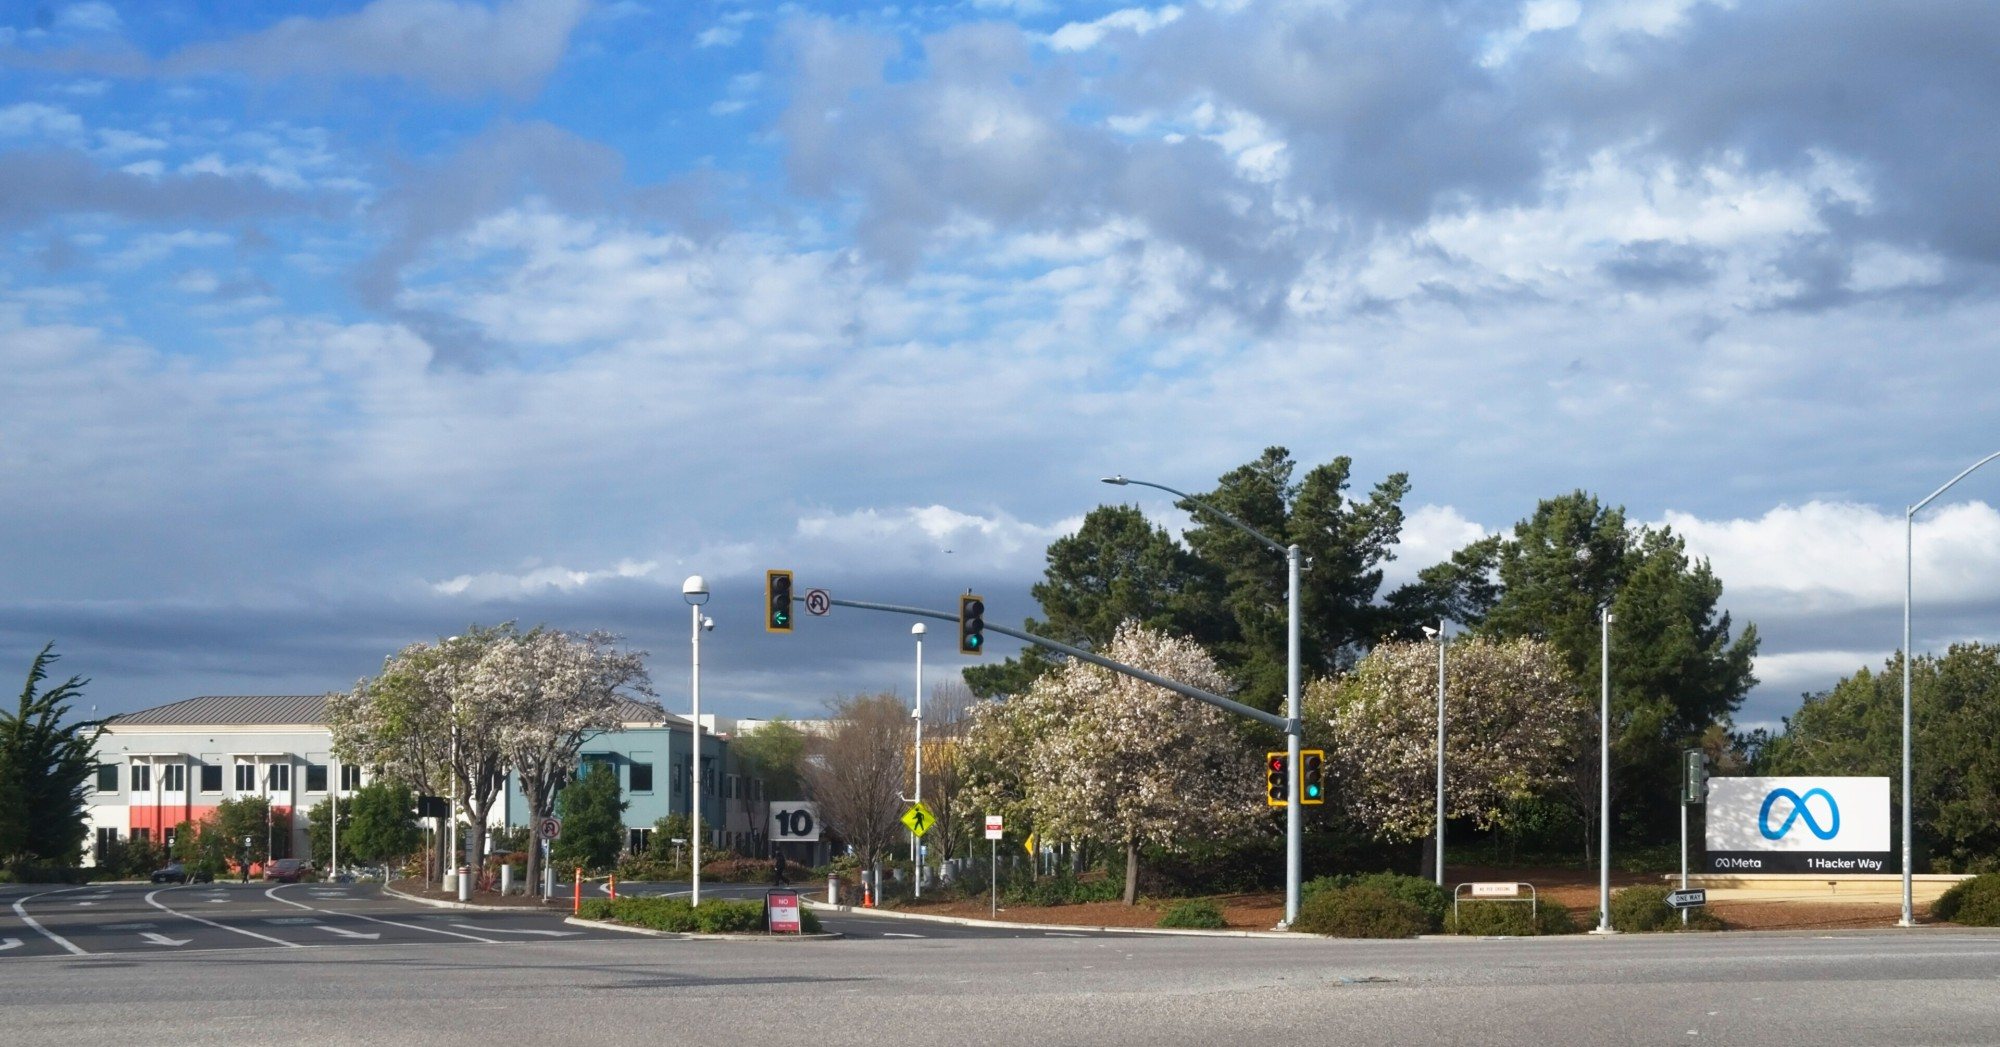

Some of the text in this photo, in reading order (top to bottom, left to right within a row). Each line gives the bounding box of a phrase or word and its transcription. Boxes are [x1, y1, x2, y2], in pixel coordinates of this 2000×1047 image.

[775, 810, 813, 836] 10
[1732, 858, 1761, 868] Meta
[1807, 858, 1882, 870] 1 Hacker Way
